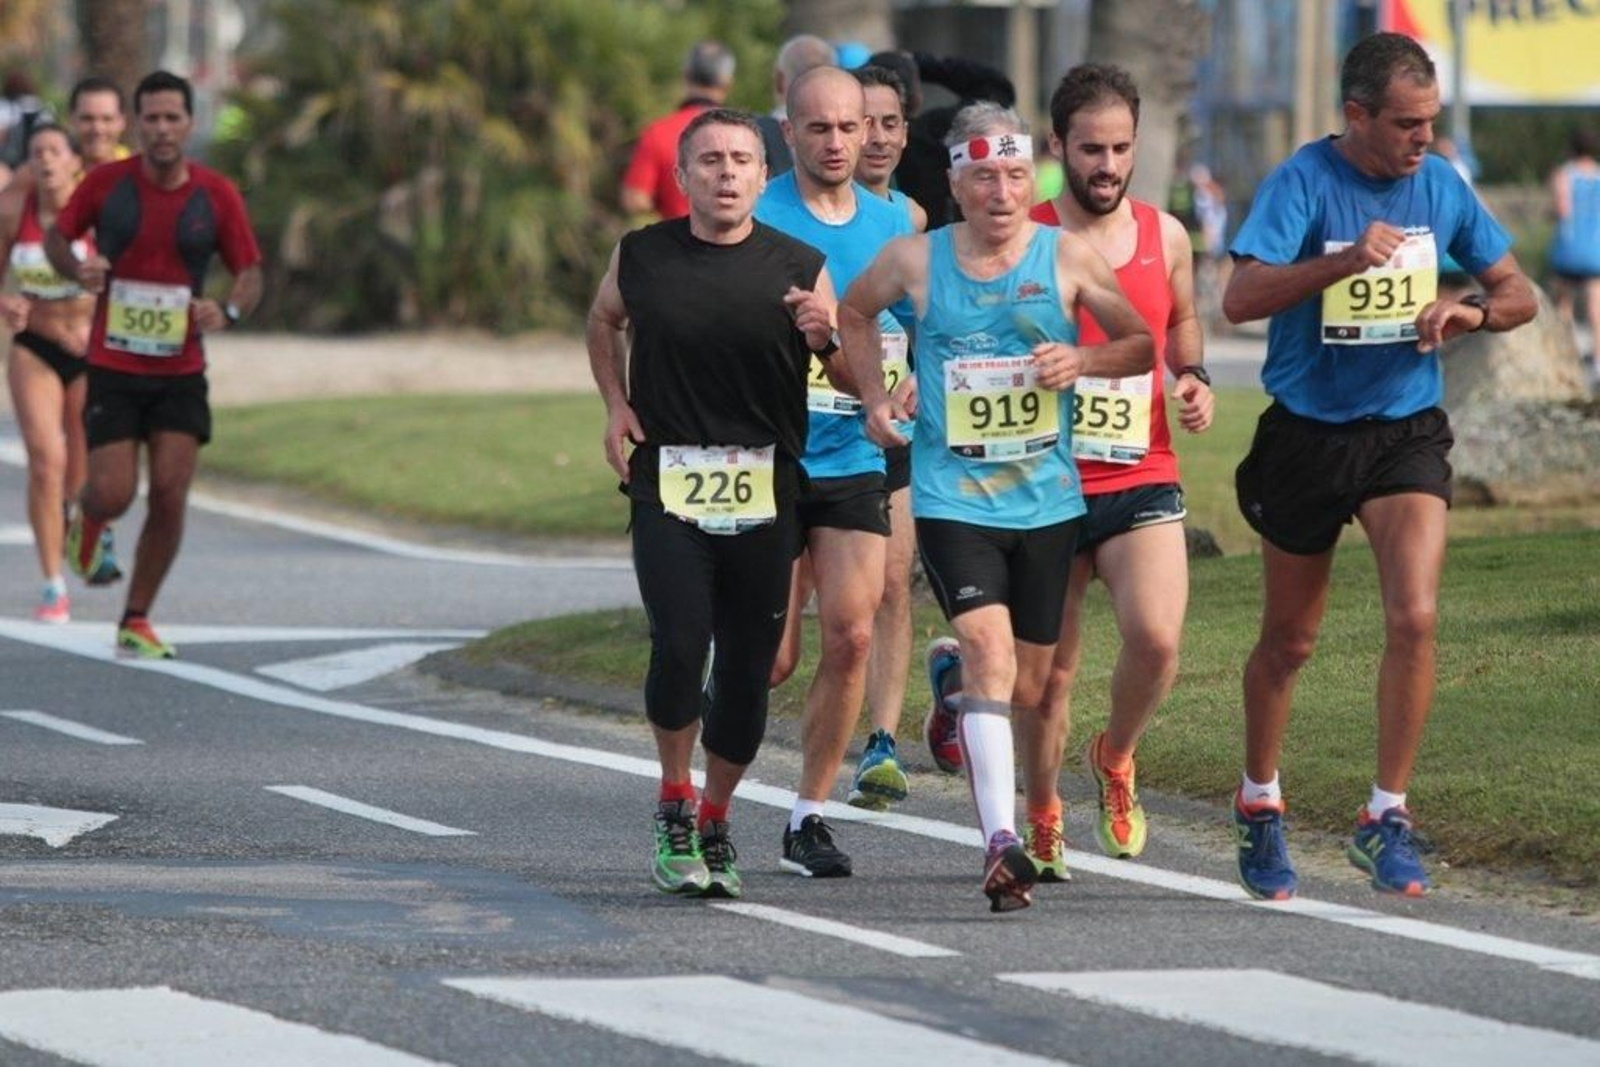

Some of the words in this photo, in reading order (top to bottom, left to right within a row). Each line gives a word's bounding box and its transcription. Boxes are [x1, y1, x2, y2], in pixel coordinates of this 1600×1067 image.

[1349, 275, 1416, 311] 931
[124, 307, 171, 335] 505
[969, 391, 1040, 430] 919
[684, 471, 752, 505] 226
